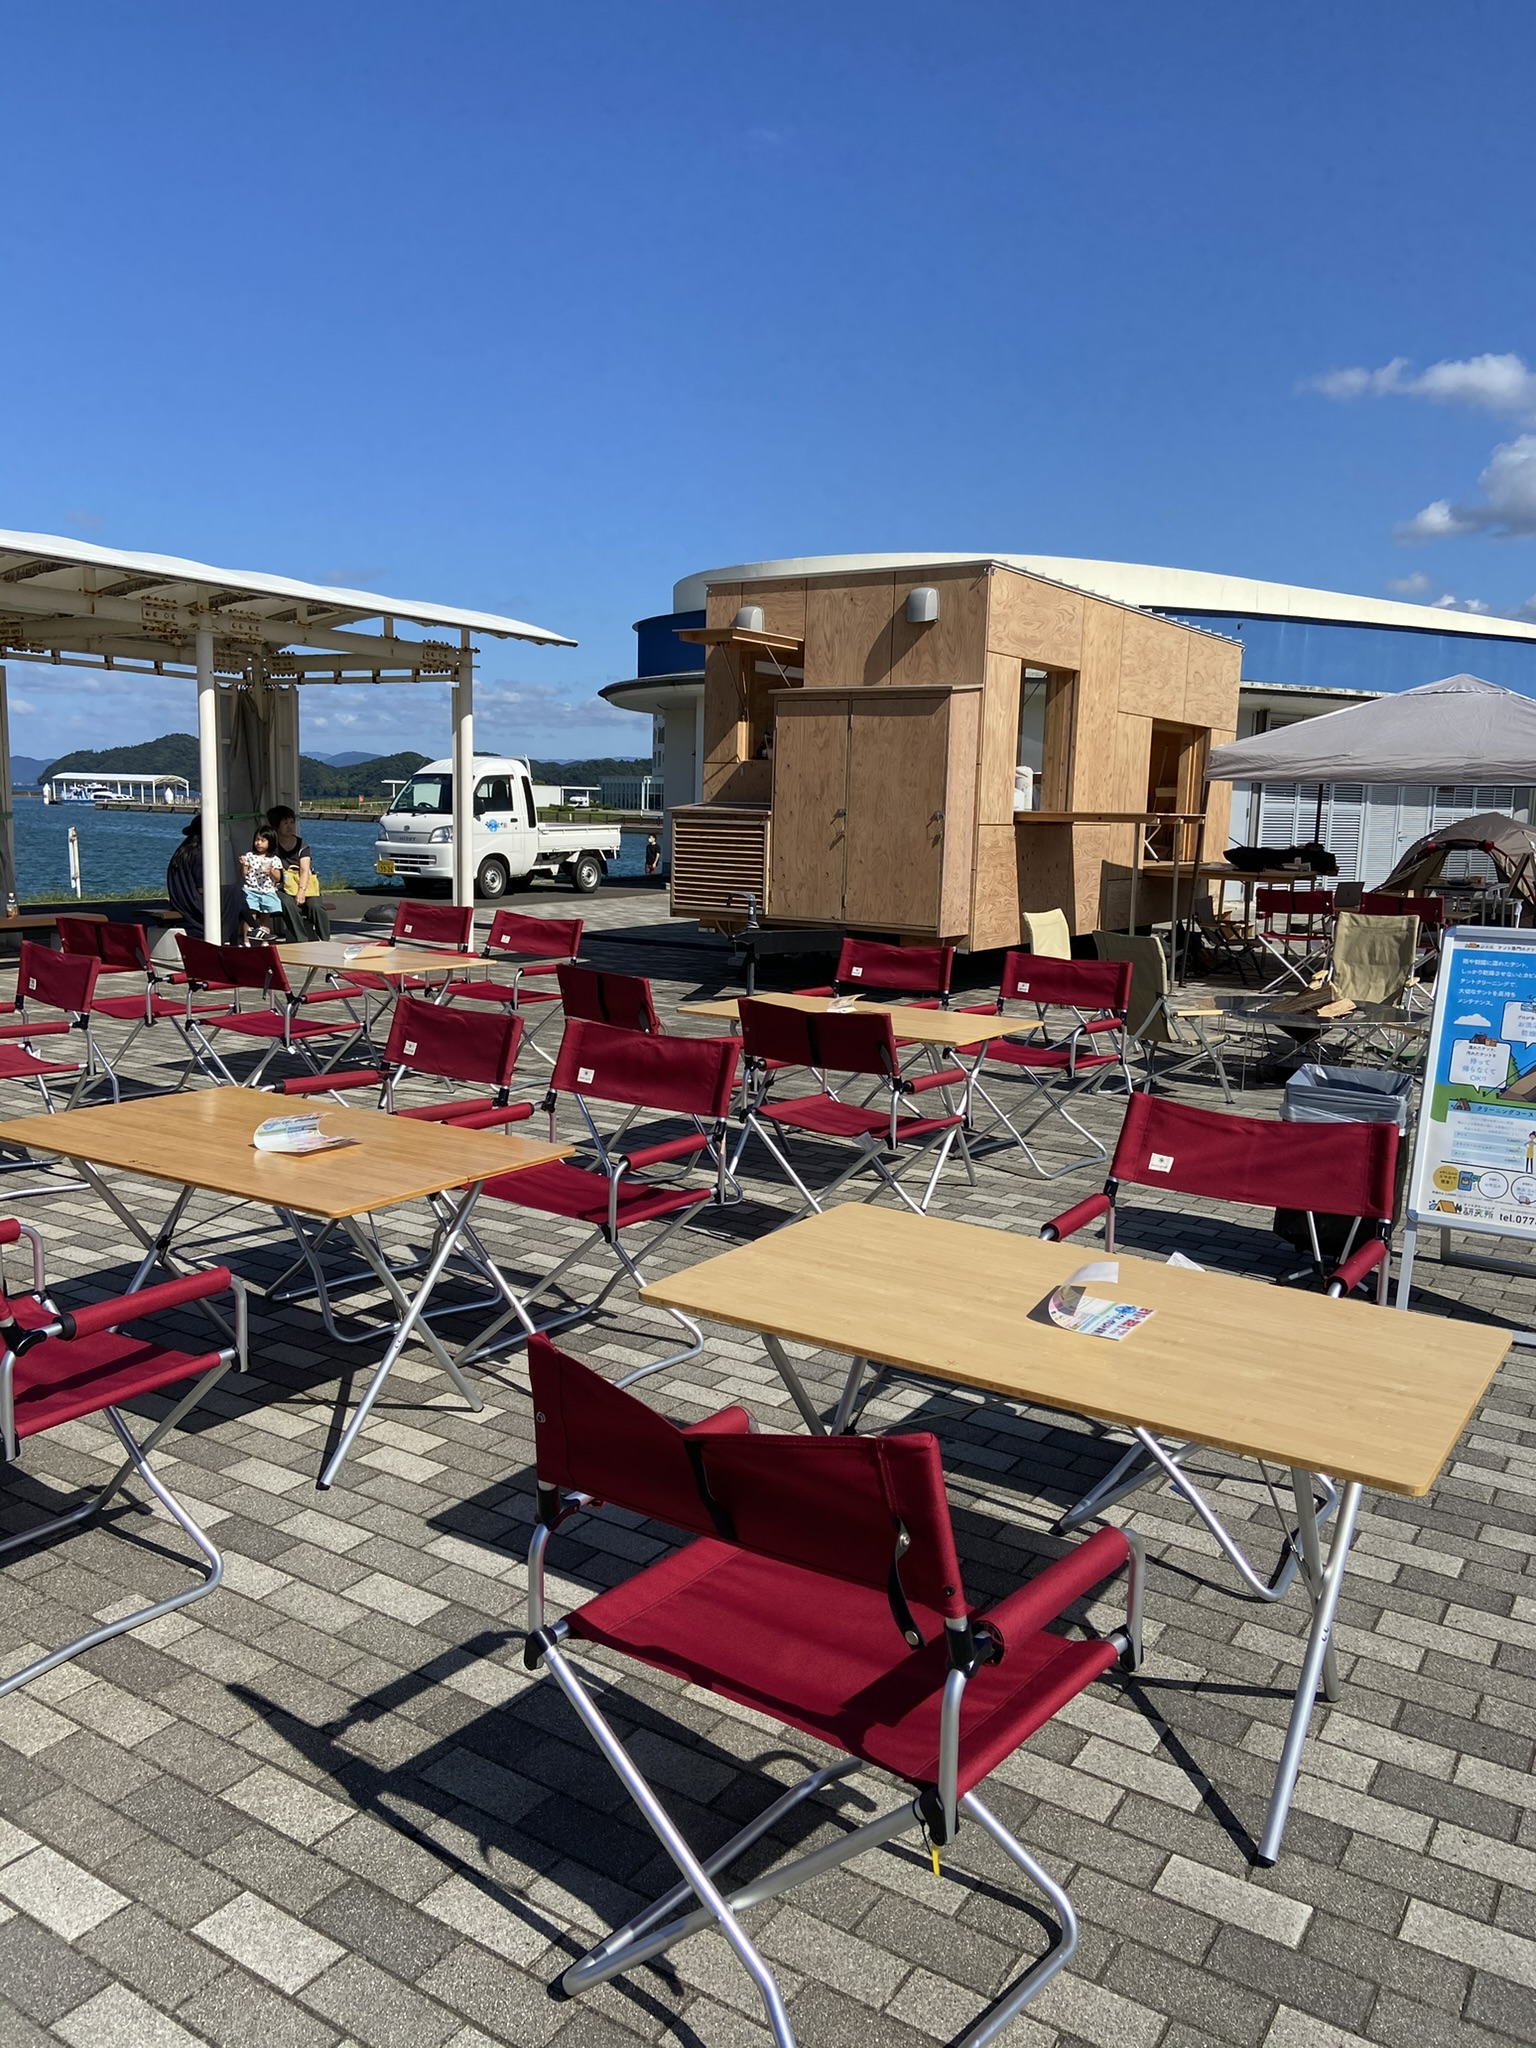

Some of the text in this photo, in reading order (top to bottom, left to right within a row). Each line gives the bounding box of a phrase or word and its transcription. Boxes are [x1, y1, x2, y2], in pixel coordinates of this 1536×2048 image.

[1461, 969, 1536, 979] しっかり乾燥させないとカビ
[1477, 1106, 1534, 1118] クリーニングコース
[1463, 1207, 1494, 1219] 研究所
[1499, 1213, 1536, 1226] tel.077
